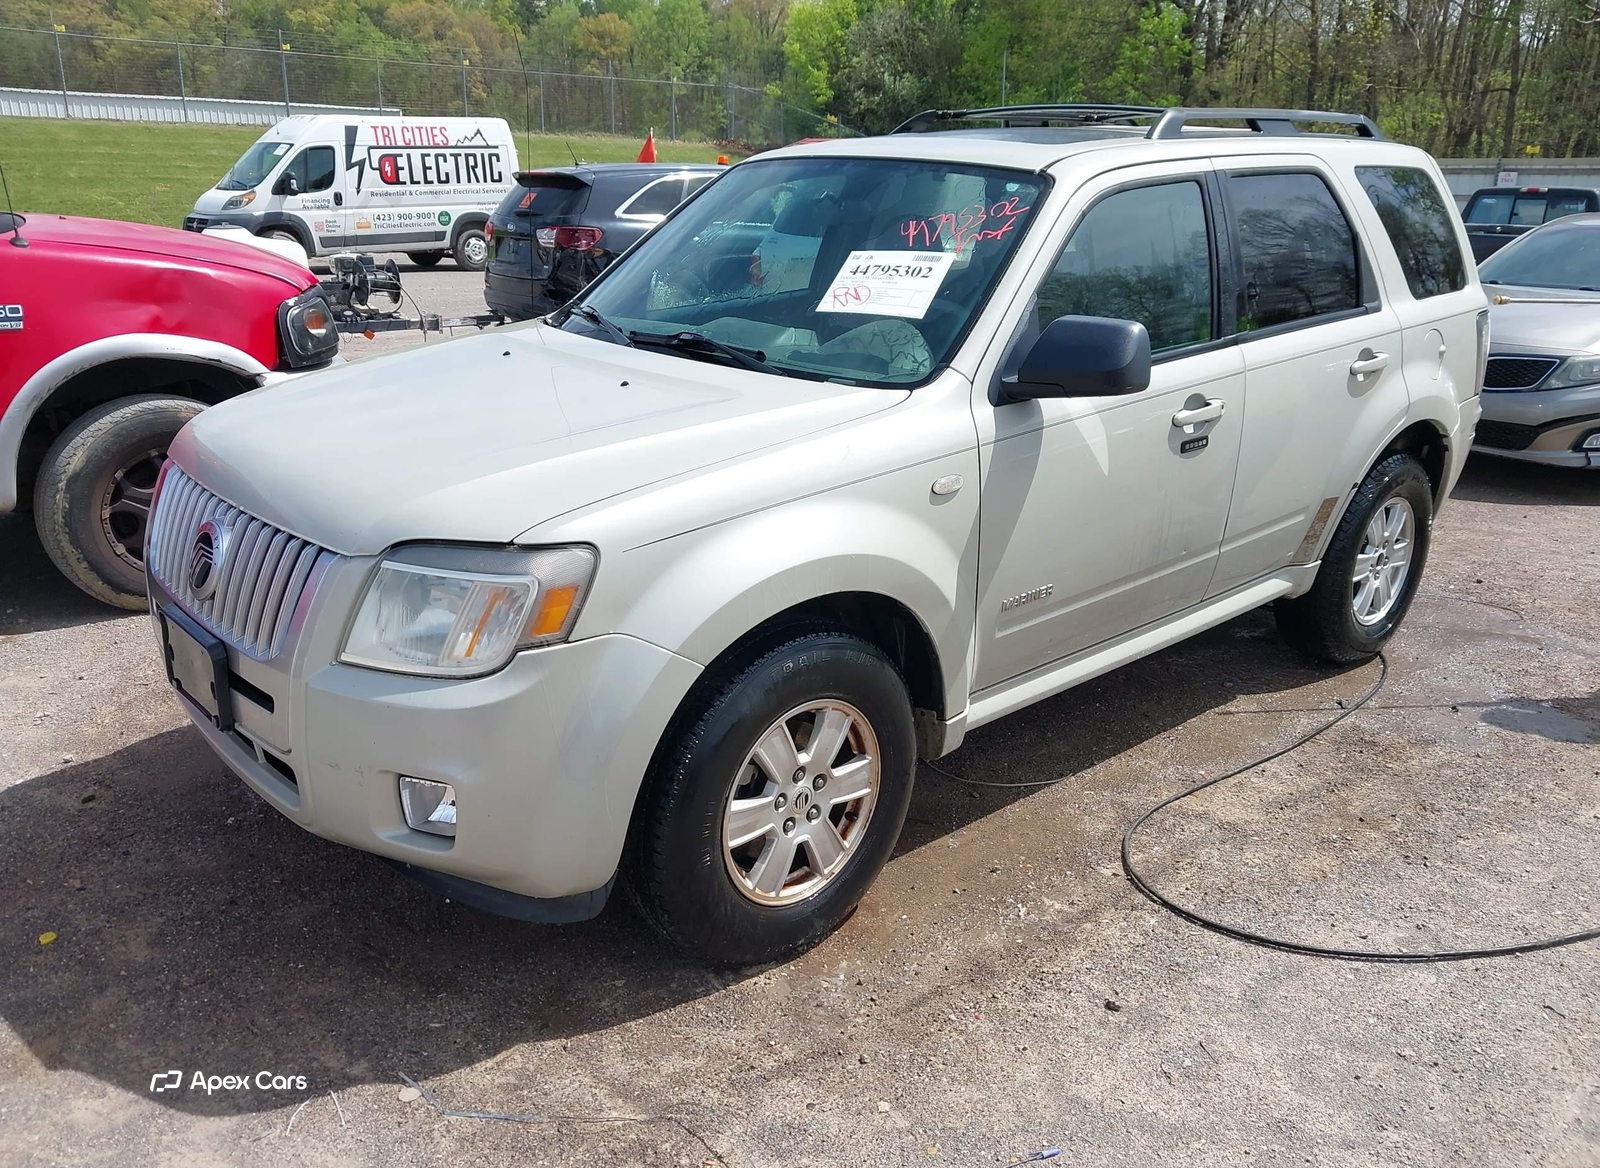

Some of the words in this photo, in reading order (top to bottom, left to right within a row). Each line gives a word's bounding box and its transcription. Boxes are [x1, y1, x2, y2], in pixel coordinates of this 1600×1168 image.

[370, 125, 397, 146] TRI
[400, 125, 449, 146] CITIES
[395, 152, 503, 185] ELECTRIC
[370, 190, 408, 198] Residential
[372, 213, 395, 223] (423)
[397, 212, 437, 221] 900-9001
[373, 221, 437, 230] TriCitiesElectric.com
[849, 264, 933, 279] 44795302
[1001, 583, 1054, 613] MARINER
